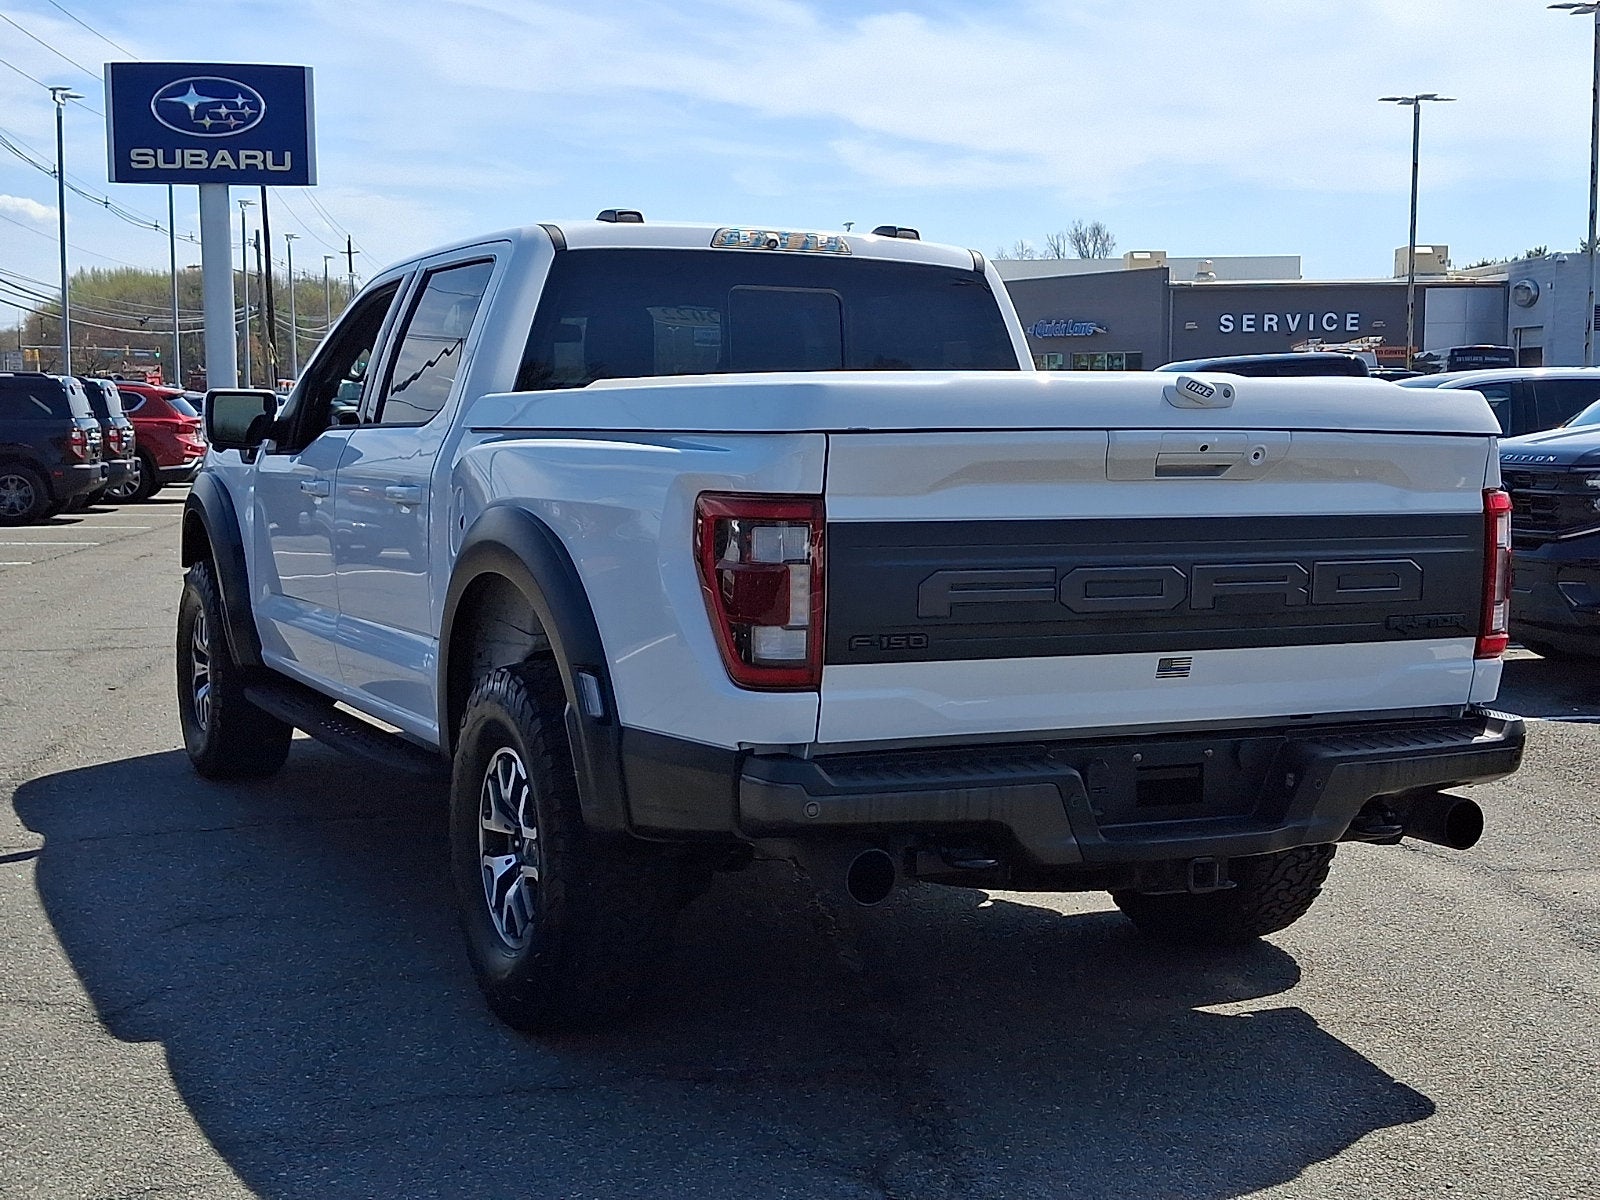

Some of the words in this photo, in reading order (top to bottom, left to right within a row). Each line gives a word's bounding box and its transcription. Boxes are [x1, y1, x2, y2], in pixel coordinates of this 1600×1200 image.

[130, 148, 292, 171] SUBARU
[1219, 312, 1360, 333] SERVICE
[1500, 454, 1558, 462] DITION
[917, 559, 1423, 619] FORD
[1385, 612, 1468, 633] RAPTOR
[848, 634, 929, 652] F-150
